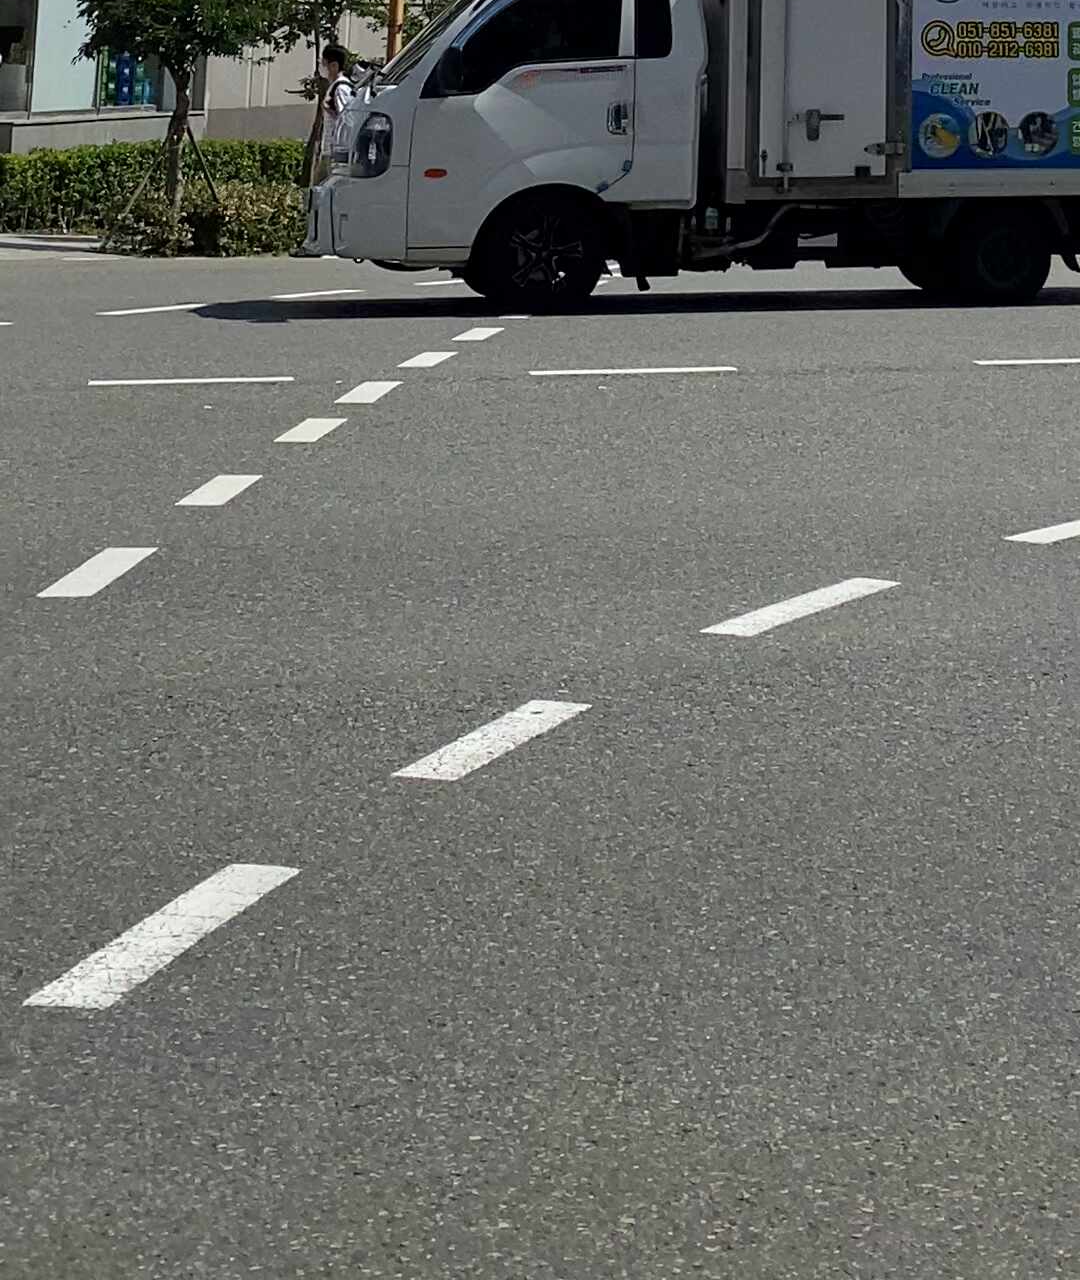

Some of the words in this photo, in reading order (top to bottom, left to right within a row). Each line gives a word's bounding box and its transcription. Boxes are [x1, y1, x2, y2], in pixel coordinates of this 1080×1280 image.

[957, 21, 1059, 40] 051-851-6381
[957, 40, 1060, 58] 010-2112-6381
[929, 81, 980, 96] CLEAN
